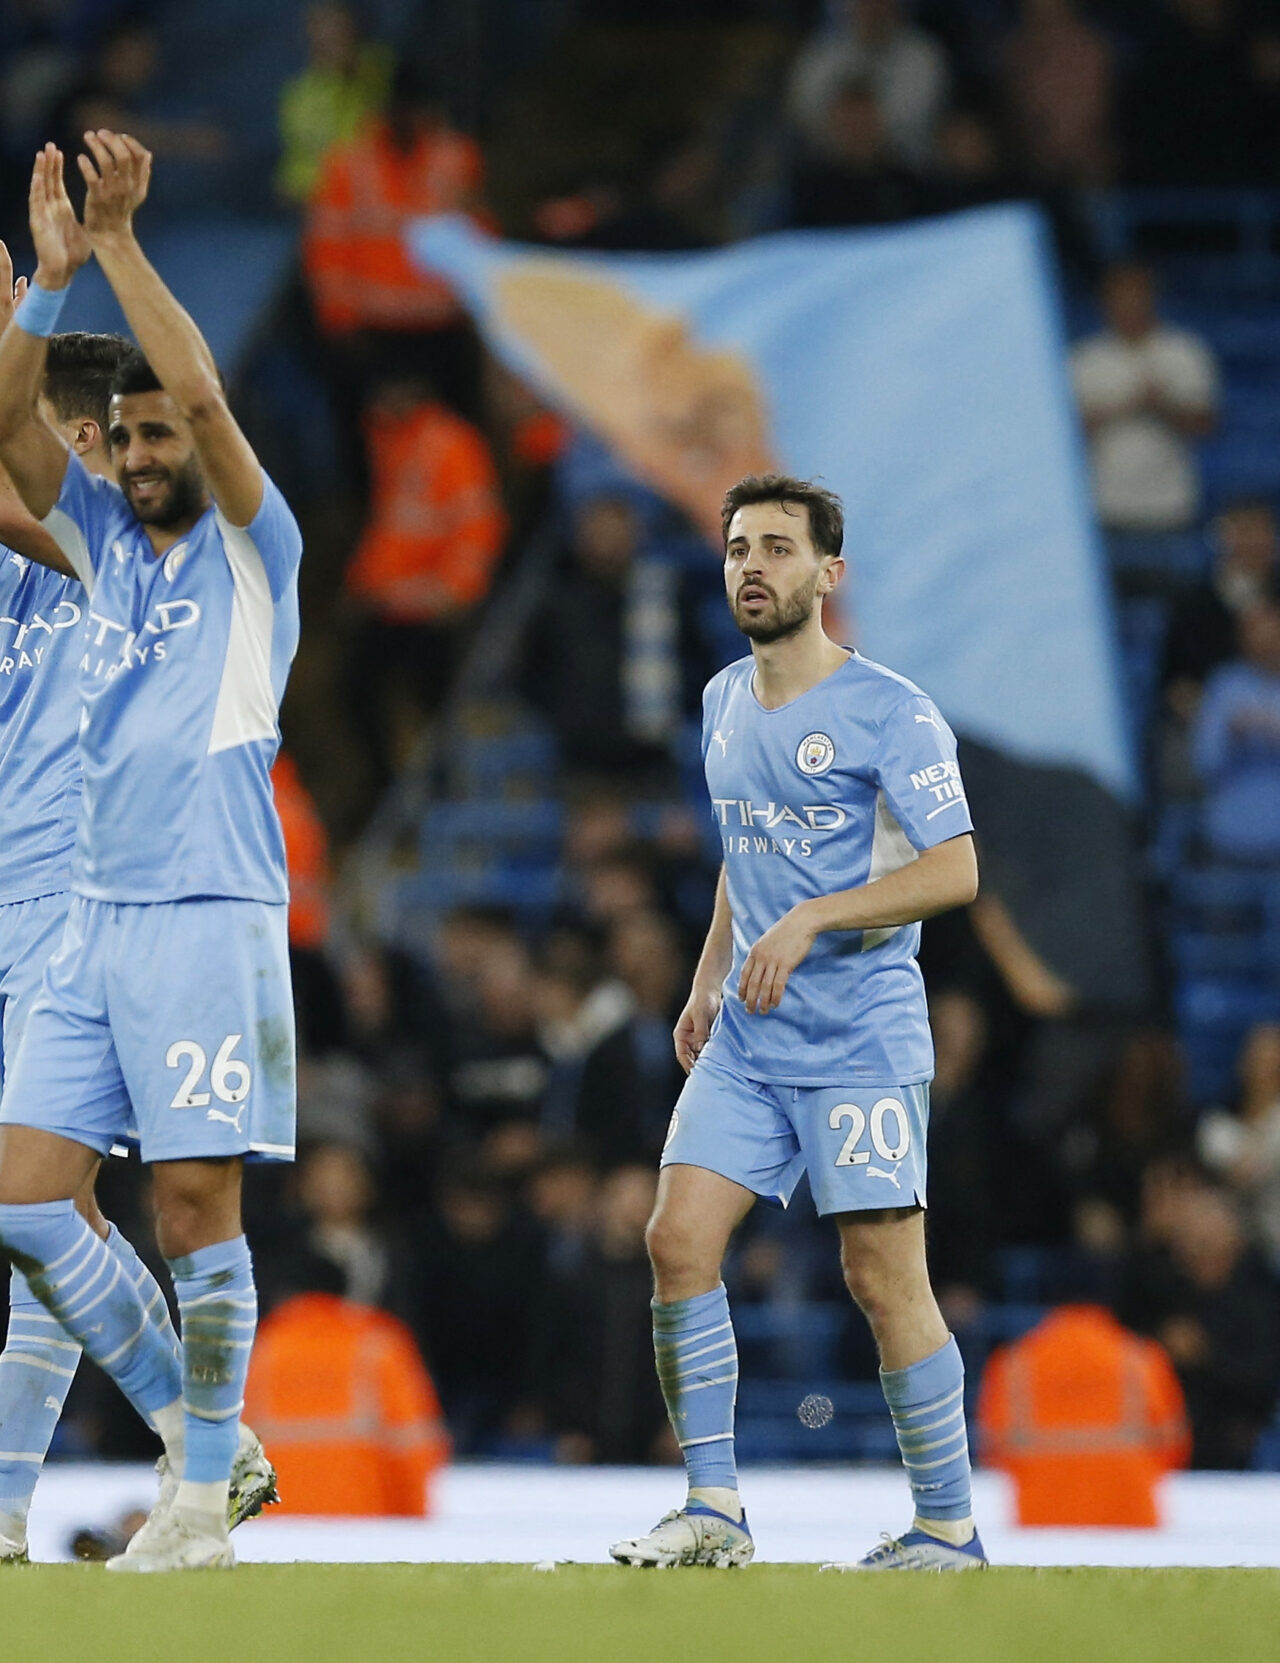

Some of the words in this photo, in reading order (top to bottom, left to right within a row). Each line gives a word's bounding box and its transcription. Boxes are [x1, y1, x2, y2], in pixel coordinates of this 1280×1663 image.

[711, 798, 846, 831] TIHAD
[166, 1034, 251, 1108] 26
[828, 1097, 910, 1167] 20
